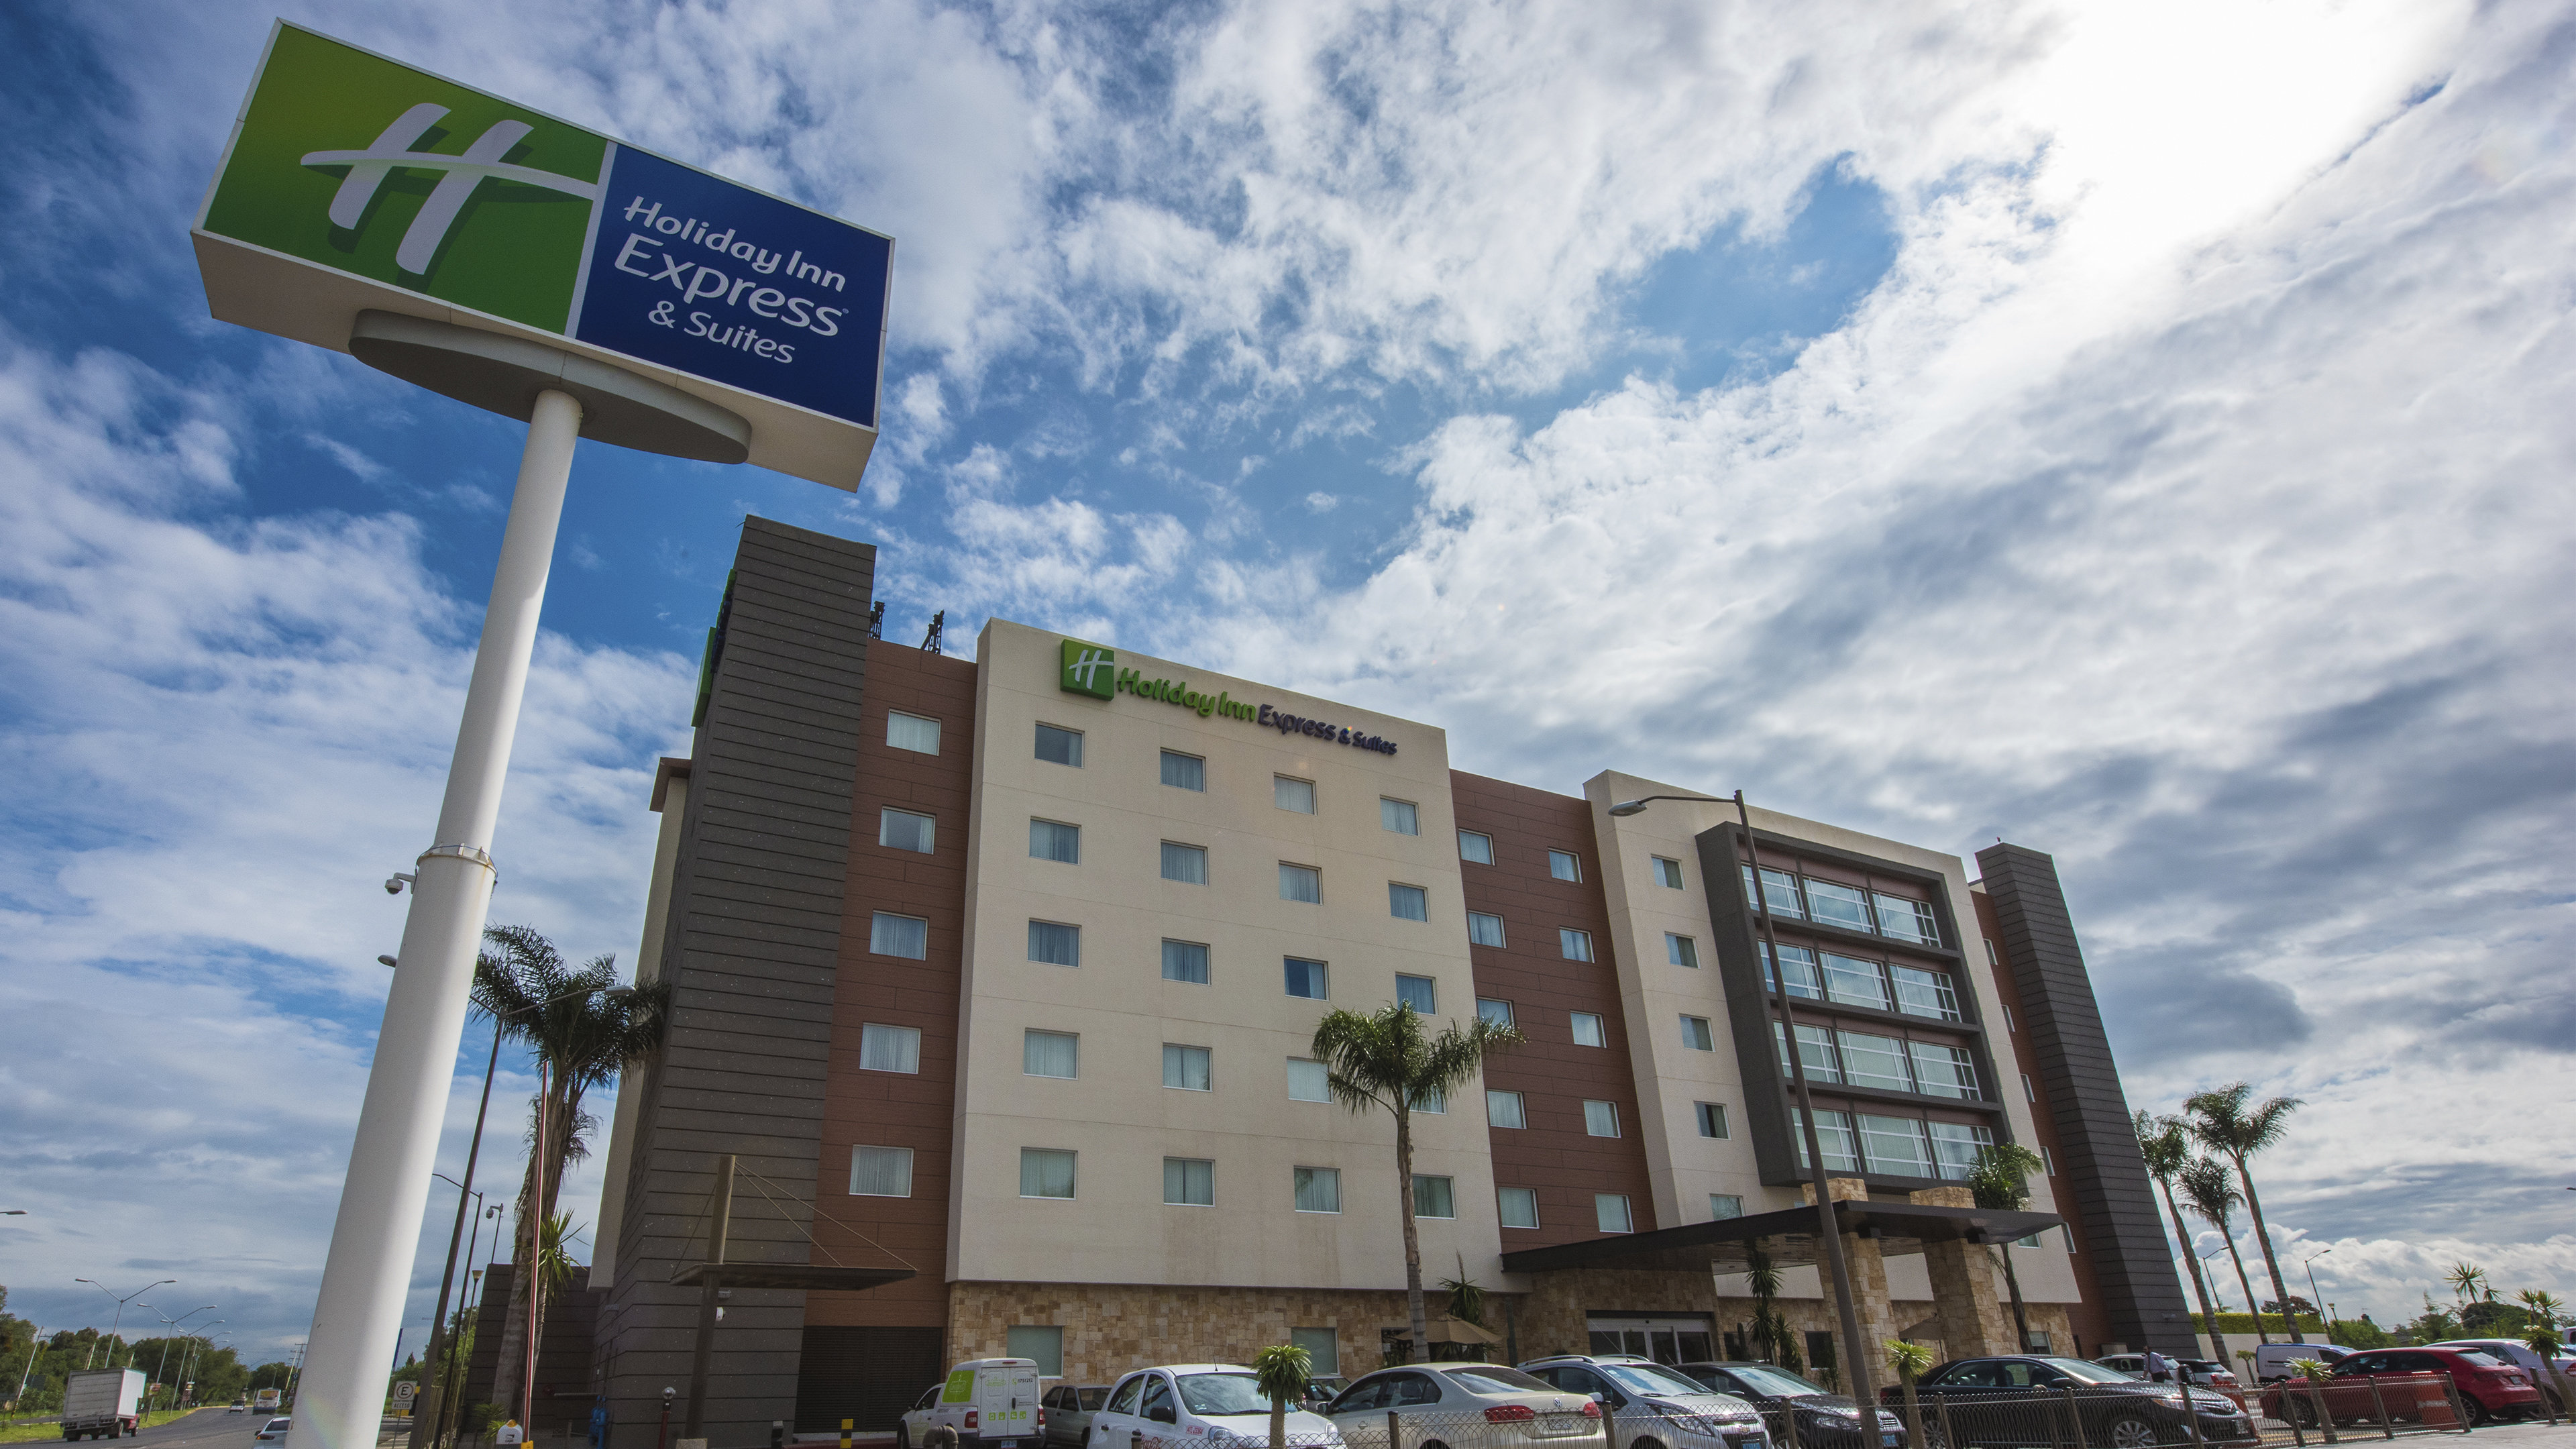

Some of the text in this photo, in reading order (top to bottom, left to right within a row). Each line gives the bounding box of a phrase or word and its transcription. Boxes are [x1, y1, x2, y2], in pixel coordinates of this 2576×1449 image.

[614, 233, 843, 336] Express
[624, 195, 846, 292] Holiday Inn
[648, 301, 796, 364] & Suites
[1117, 667, 1397, 755] Holiday Inn Express & Suites
[400, 1386, 409, 1396] E
